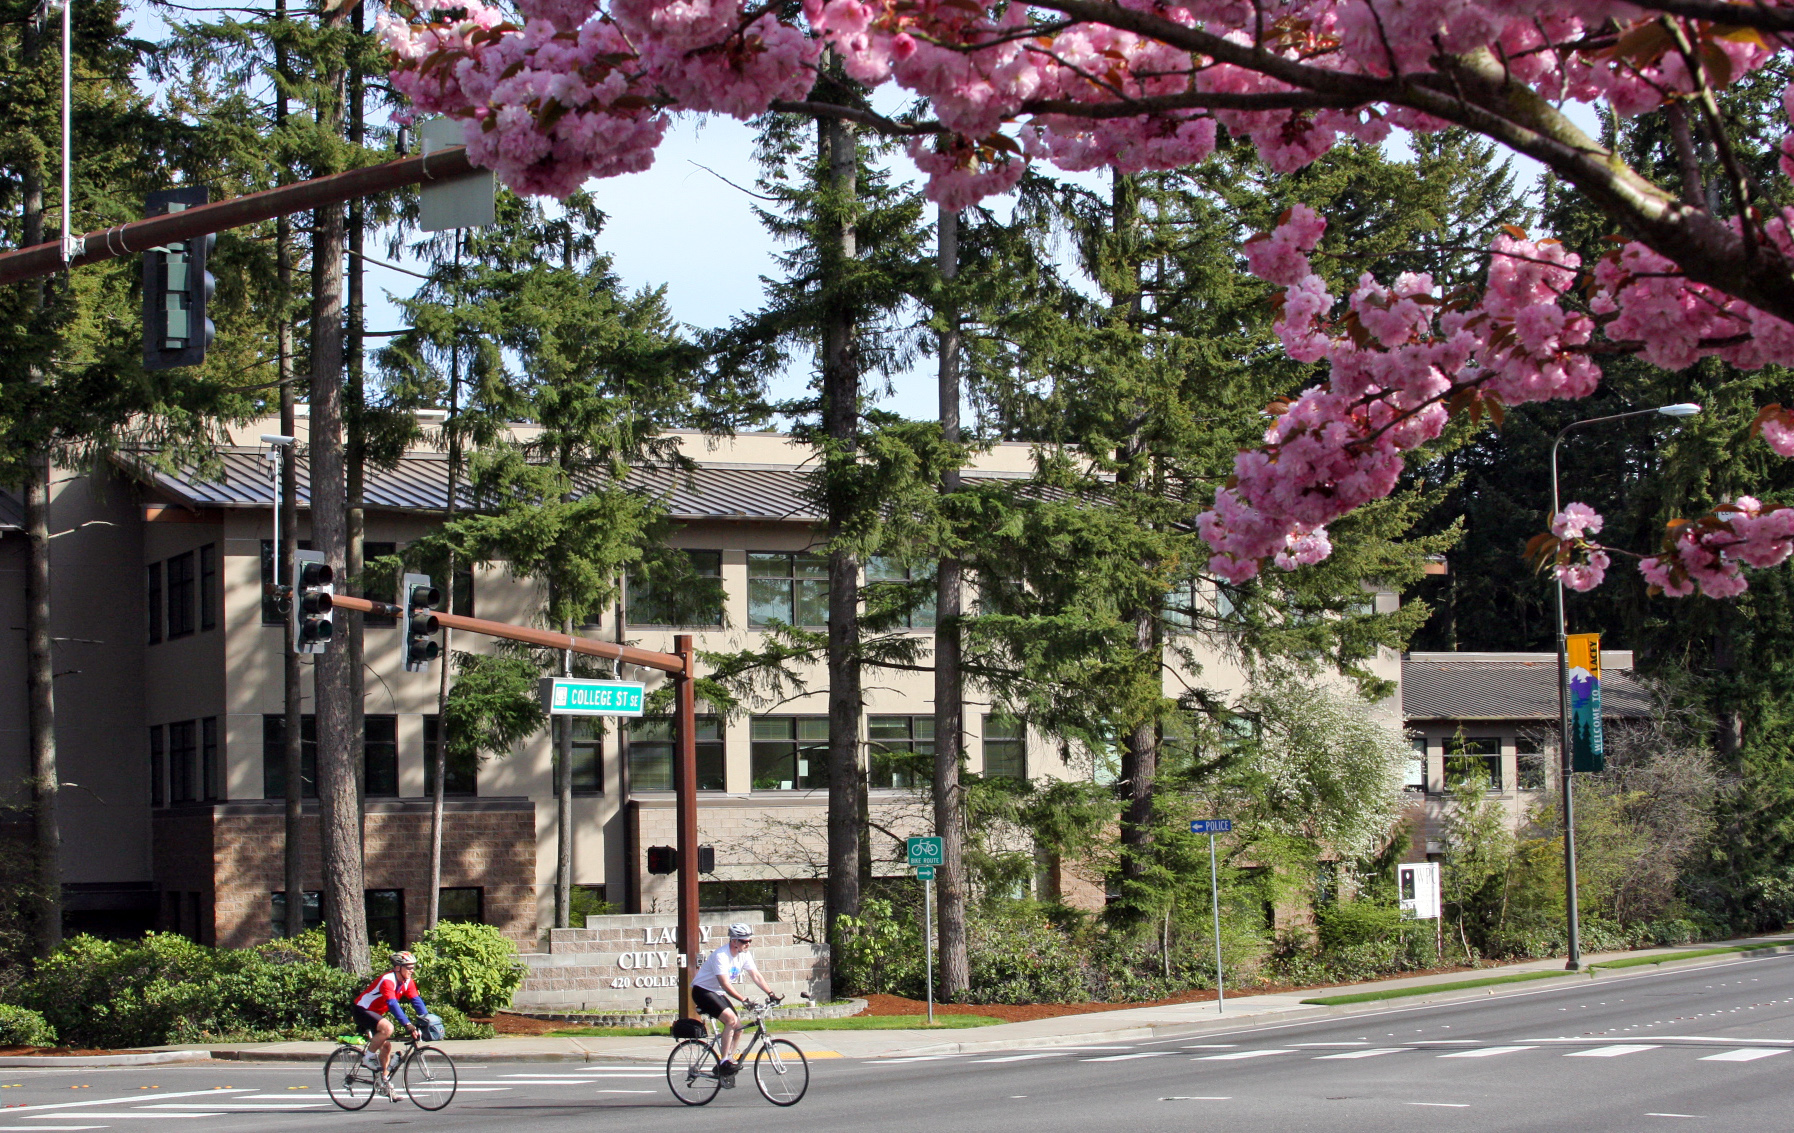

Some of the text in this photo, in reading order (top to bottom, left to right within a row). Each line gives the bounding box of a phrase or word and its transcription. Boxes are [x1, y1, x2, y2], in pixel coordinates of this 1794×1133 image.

[571, 689, 613, 706] COLLEGE
[616, 691, 628, 706] ST
[630, 695, 639, 706] SE
[1589, 641, 1602, 751] WELCOME TO LACEY
[1205, 820, 1229, 831] POLICE
[645, 926, 713, 944] LAY
[617, 951, 670, 970] CITY
[611, 975, 679, 988] 420 COLLE
